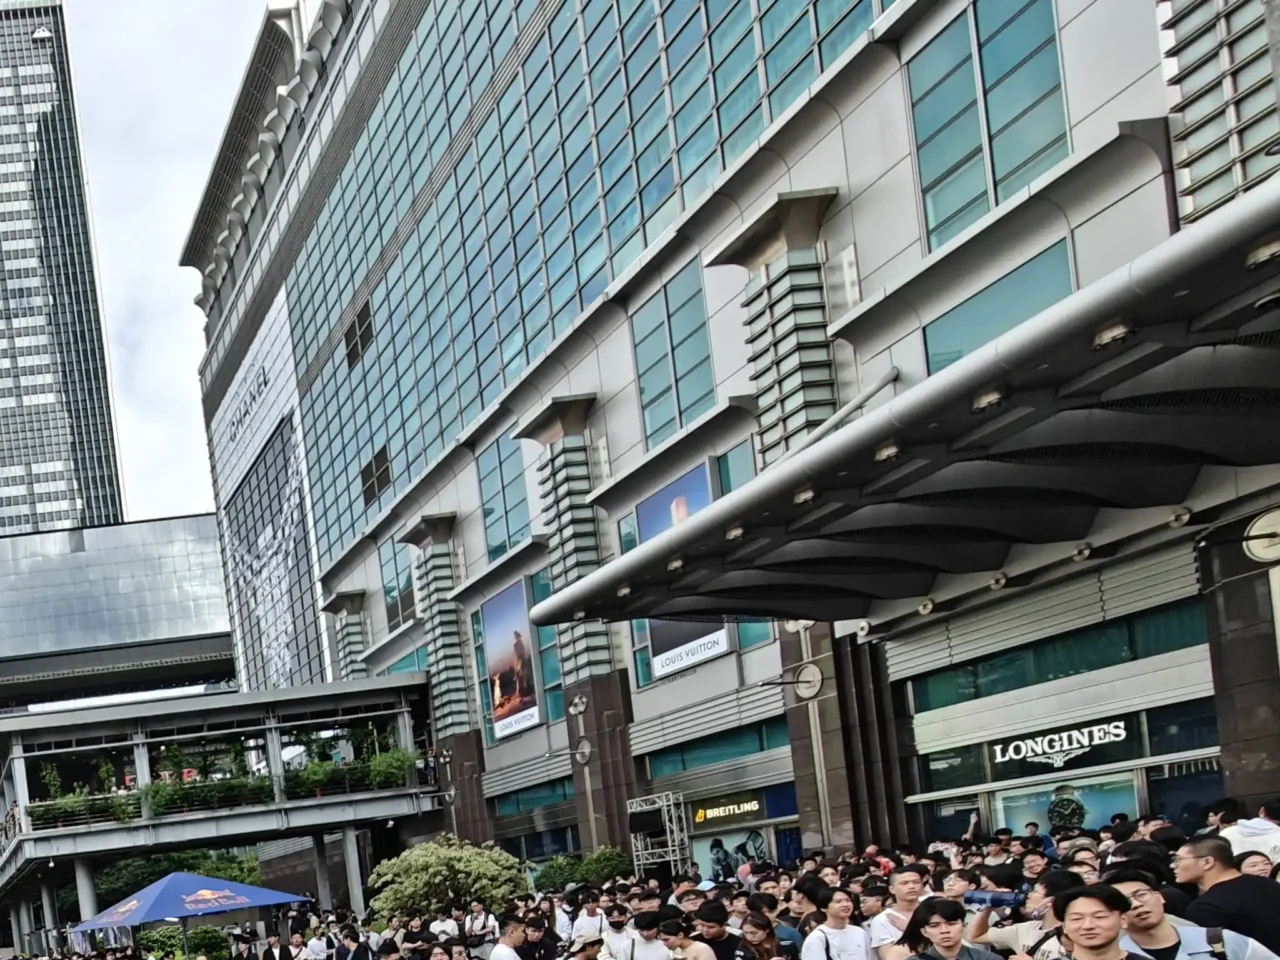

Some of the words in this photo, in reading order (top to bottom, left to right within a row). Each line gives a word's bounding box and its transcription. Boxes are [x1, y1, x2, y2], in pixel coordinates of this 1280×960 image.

[230, 366, 270, 442] CHANEL
[661, 653, 683, 668] LOUIS
[684, 638, 720, 658] VUITTON
[500, 721, 514, 732] LOUIS
[514, 713, 535, 727] VUITTON
[993, 721, 1127, 763] LONGINES
[706, 801, 760, 819] BREITLING
[184, 899, 219, 911] Red
[219, 896, 249, 907] Bull
